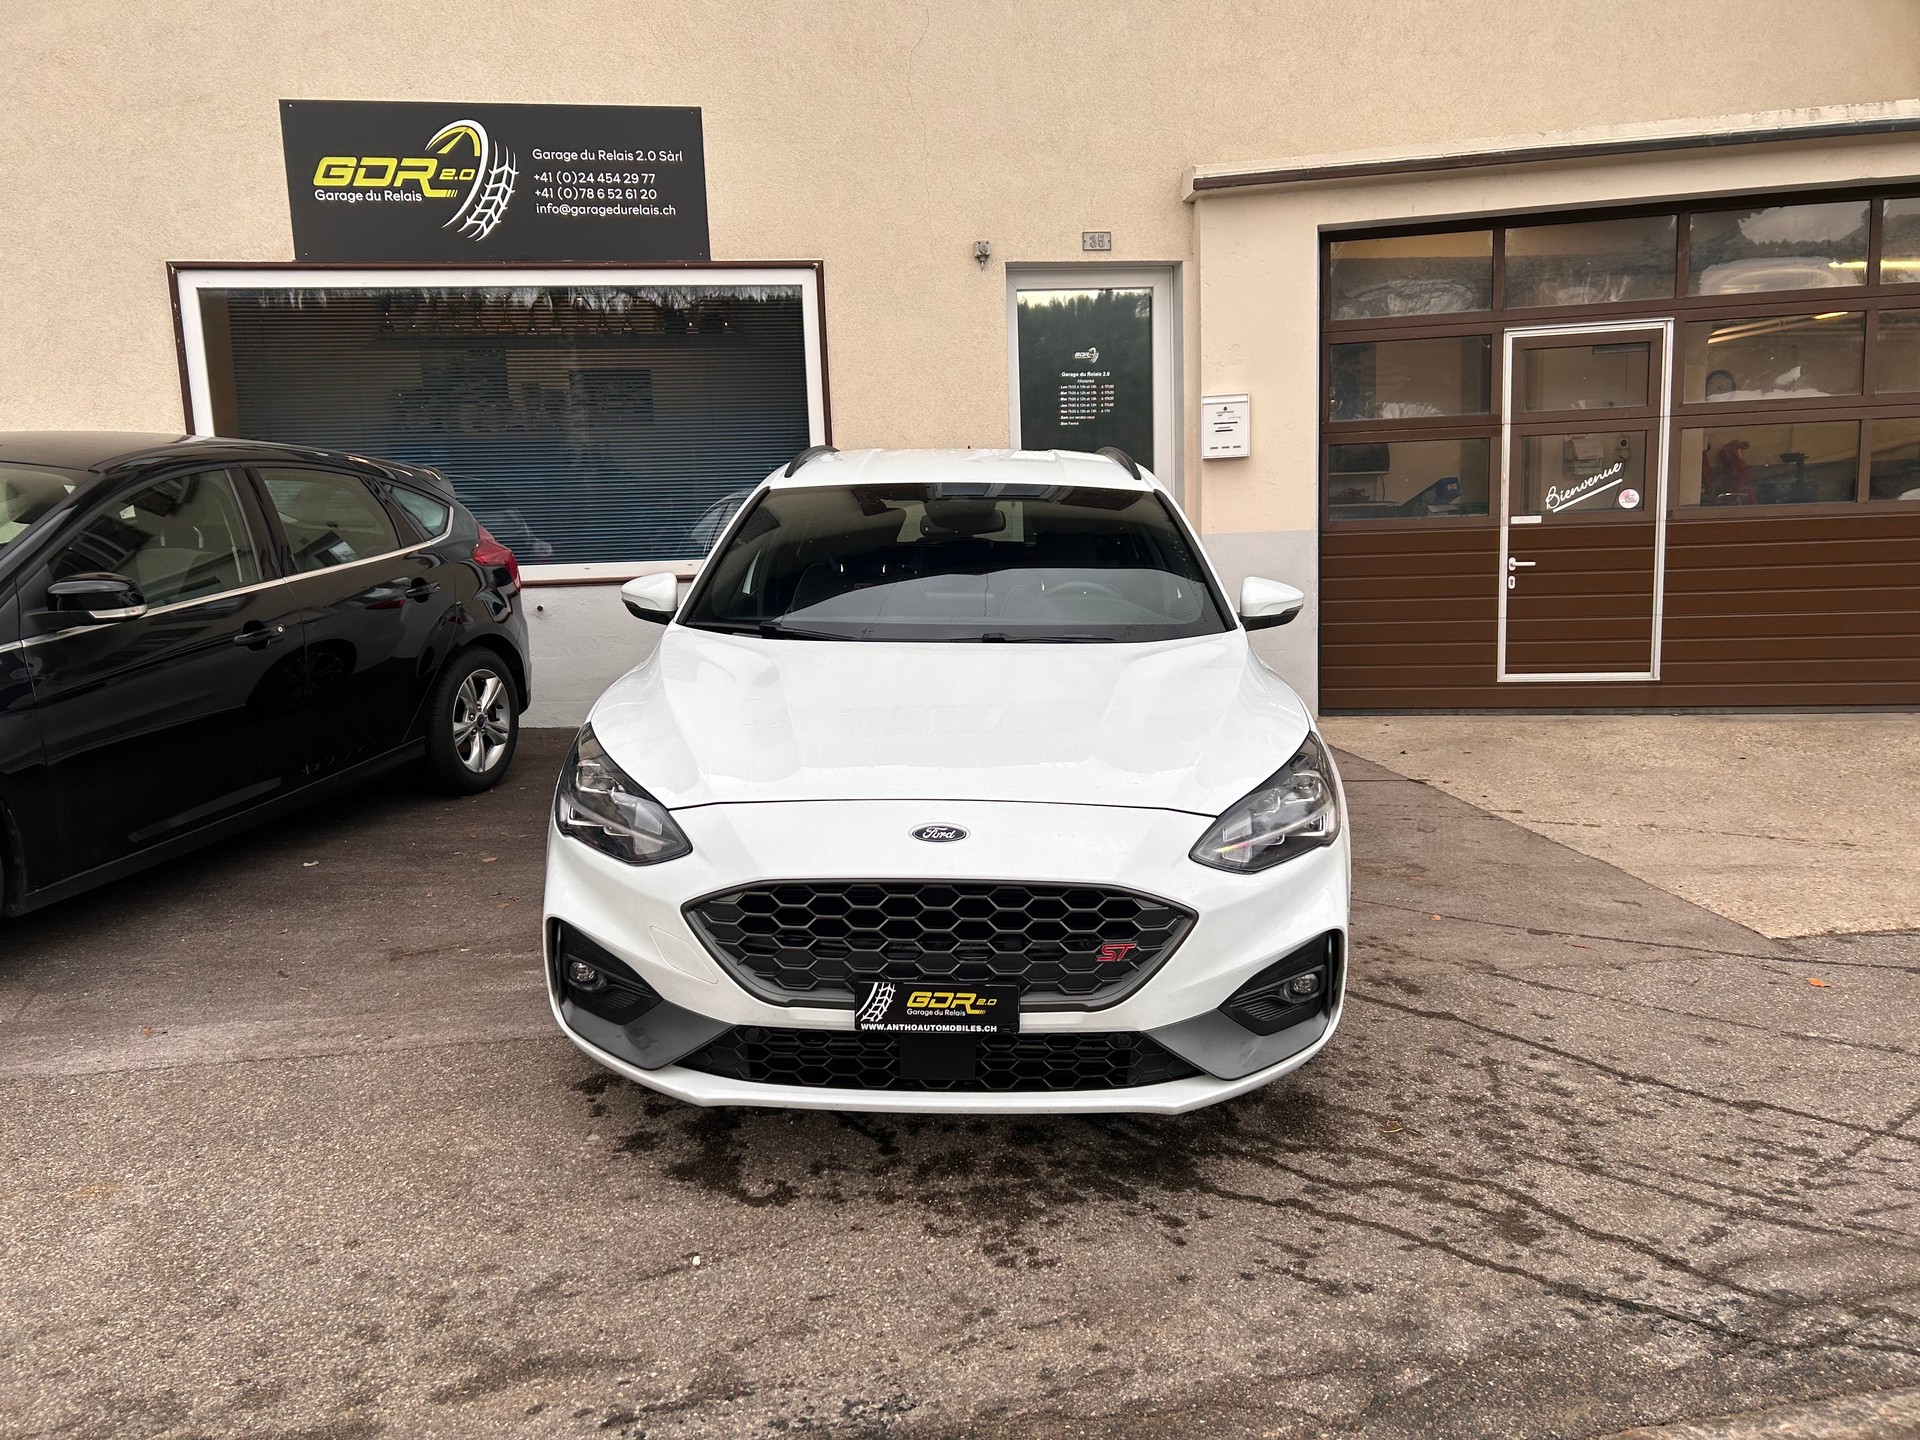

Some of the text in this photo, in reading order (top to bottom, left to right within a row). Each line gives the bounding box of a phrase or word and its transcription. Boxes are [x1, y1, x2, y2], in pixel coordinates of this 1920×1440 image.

[532, 148, 683, 163] Garage du Relais 2.0 Sàrl
[313, 156, 476, 198] GDR 2.0
[533, 170, 656, 185] +41 (0)24 454 29 77
[314, 189, 423, 203] Garage du Relais
[534, 186, 658, 200] +41 (0)78 6 52 61 20
[536, 202, 676, 217] info@garagedurelais.ch
[1545, 462, 1622, 510] Bienvenue
[922, 827, 956, 839] Ford
[1096, 943, 1137, 962] ST
[906, 991, 998, 1015] GDR 2.0
[906, 1008, 966, 1017] Garage du Relais
[861, 1023, 998, 1033] WWW.ANTHOAUTOMOBILES.CH
